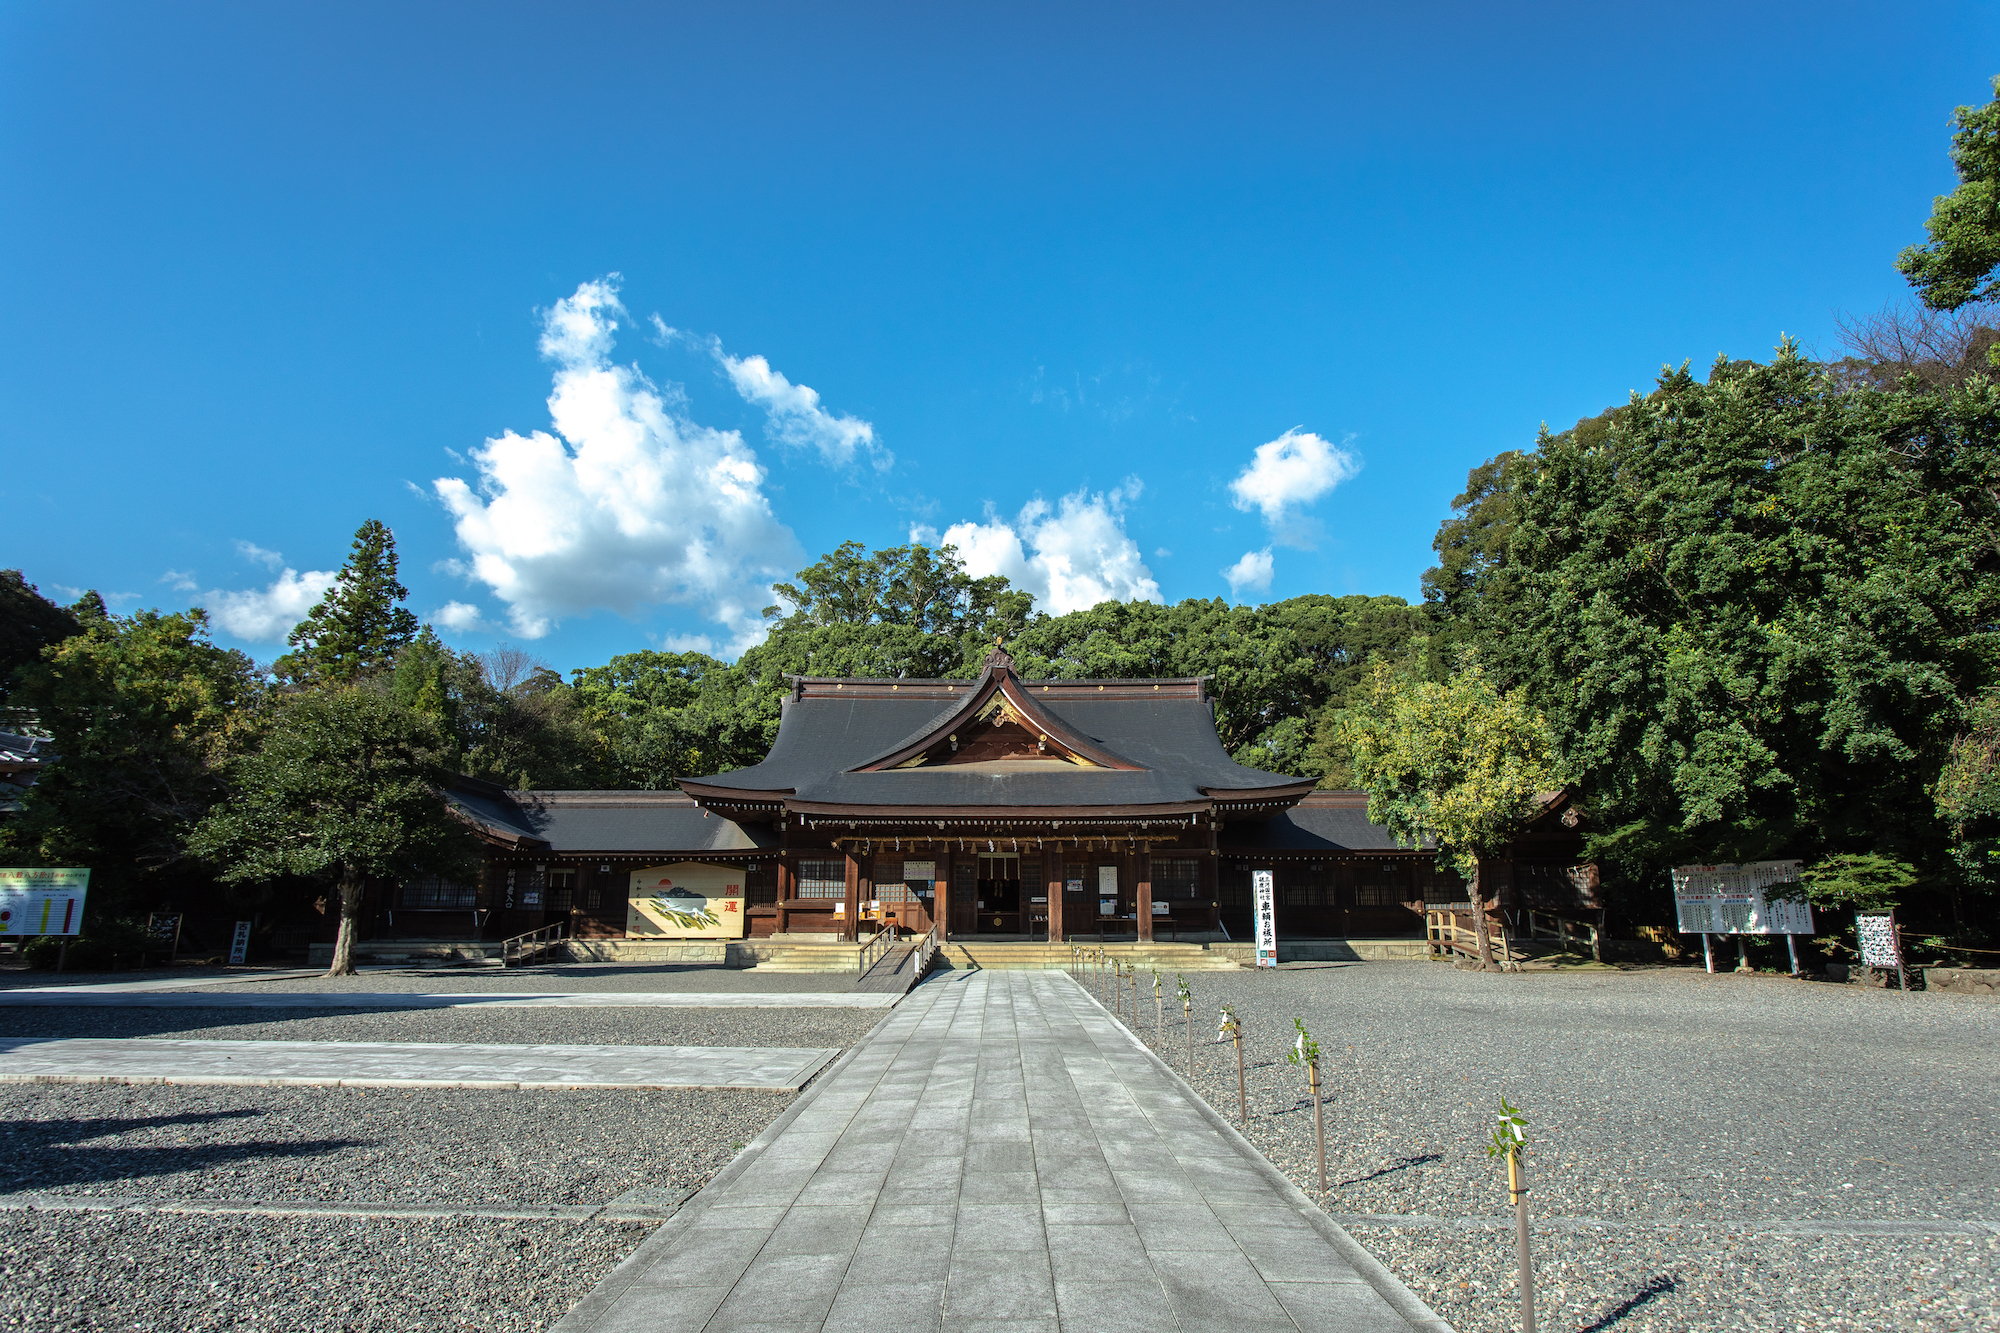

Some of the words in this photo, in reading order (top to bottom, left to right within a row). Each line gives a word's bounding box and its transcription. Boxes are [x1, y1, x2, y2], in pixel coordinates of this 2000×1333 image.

[724, 884, 739, 913] 開運
[233, 922, 249, 954] 古札納所
